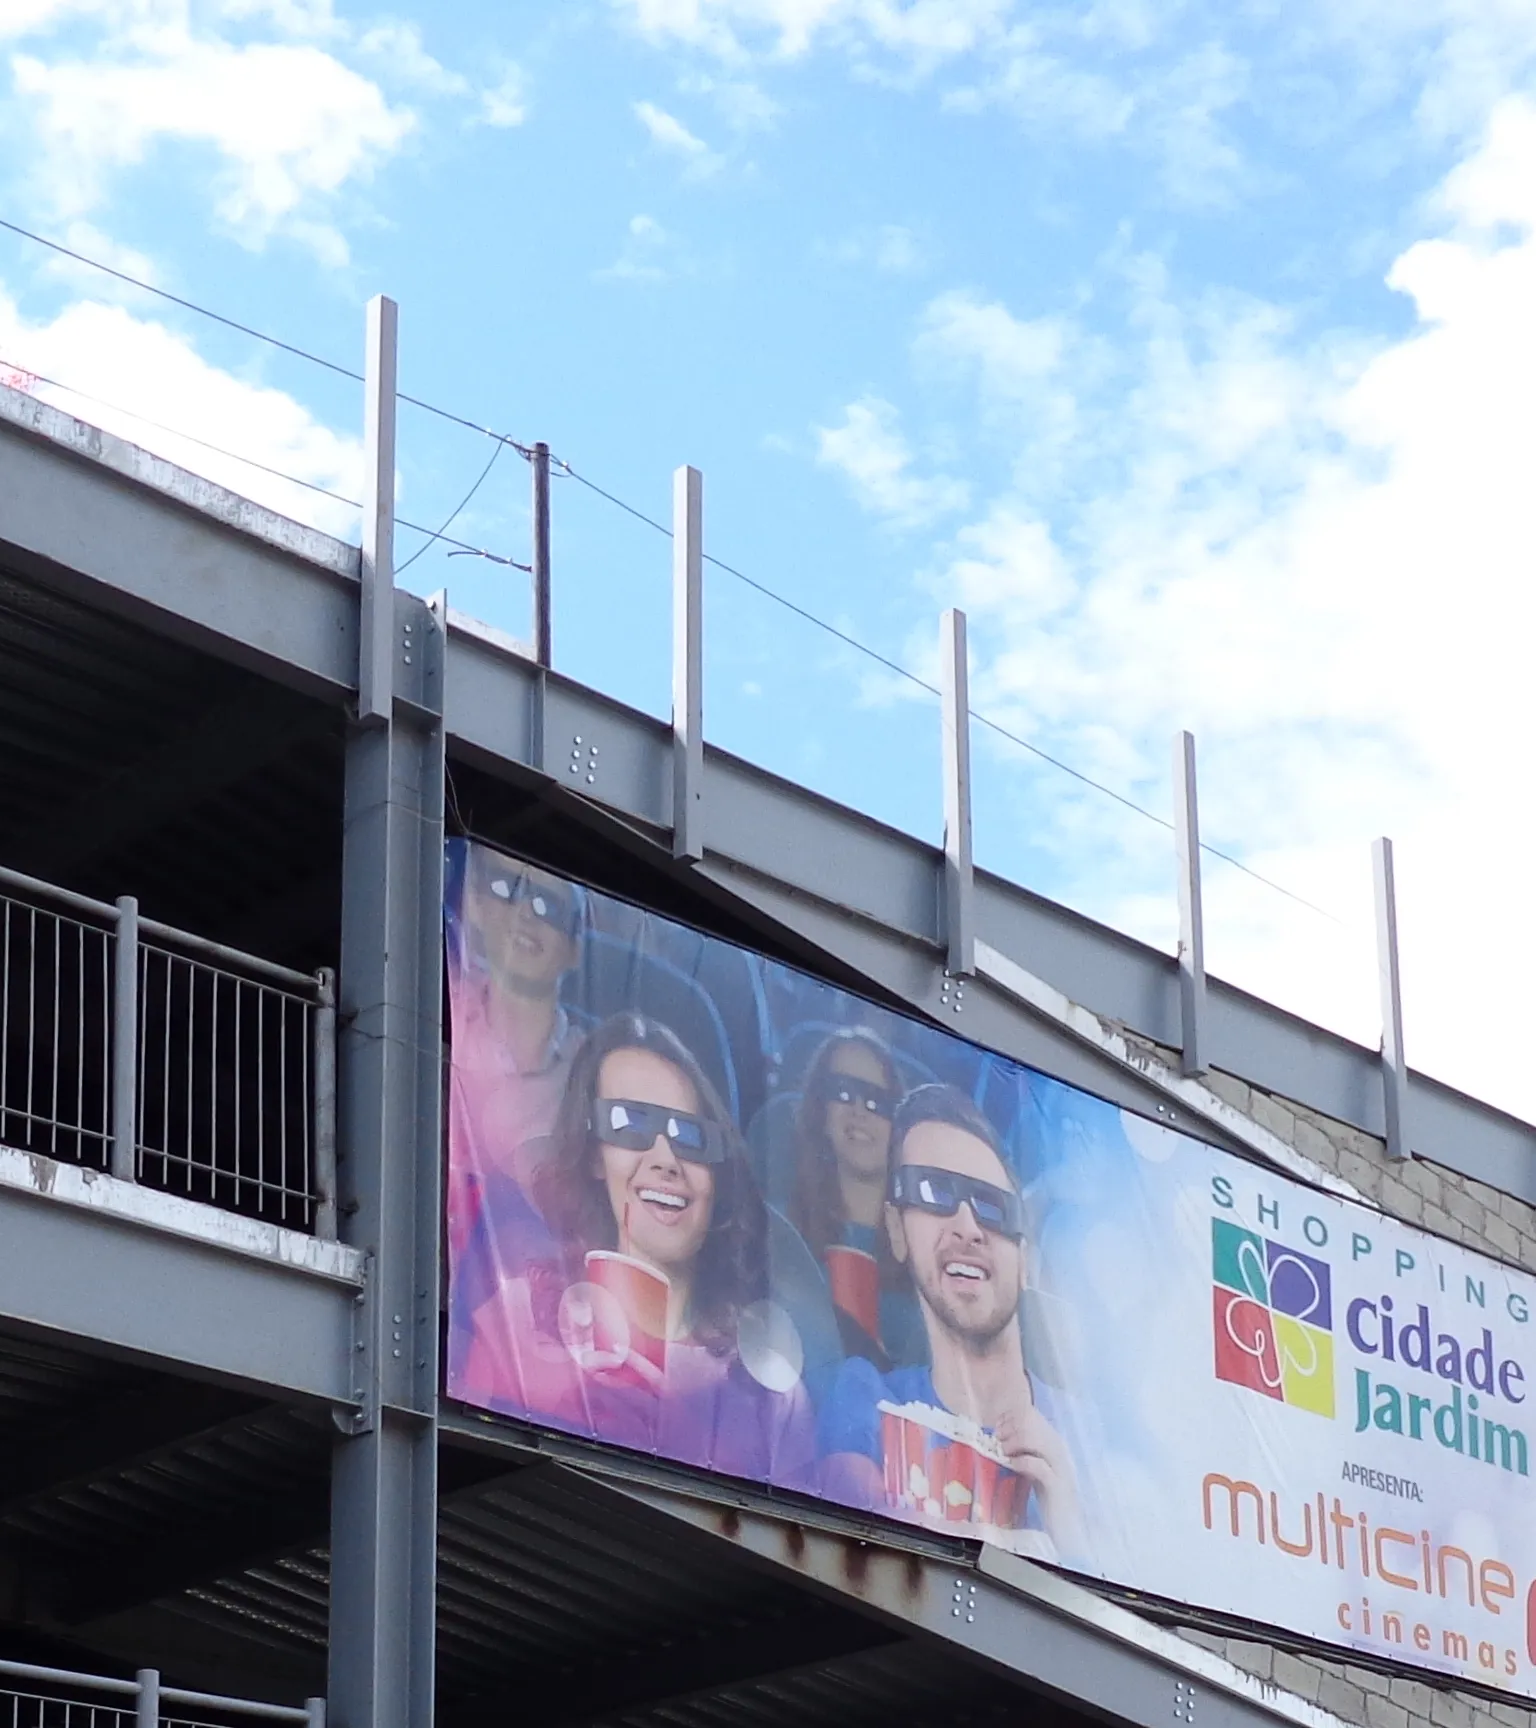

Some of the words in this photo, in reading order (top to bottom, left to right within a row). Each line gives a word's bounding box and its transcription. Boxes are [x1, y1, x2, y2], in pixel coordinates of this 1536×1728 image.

[1211, 1176, 1530, 1323] SHOPPING
[1354, 1368, 1529, 1477] Jardim
[1341, 1461, 1424, 1503] APRESENTA:
[1202, 1472, 1516, 1615] multicine
[1337, 1599, 1518, 1676] cinemas
